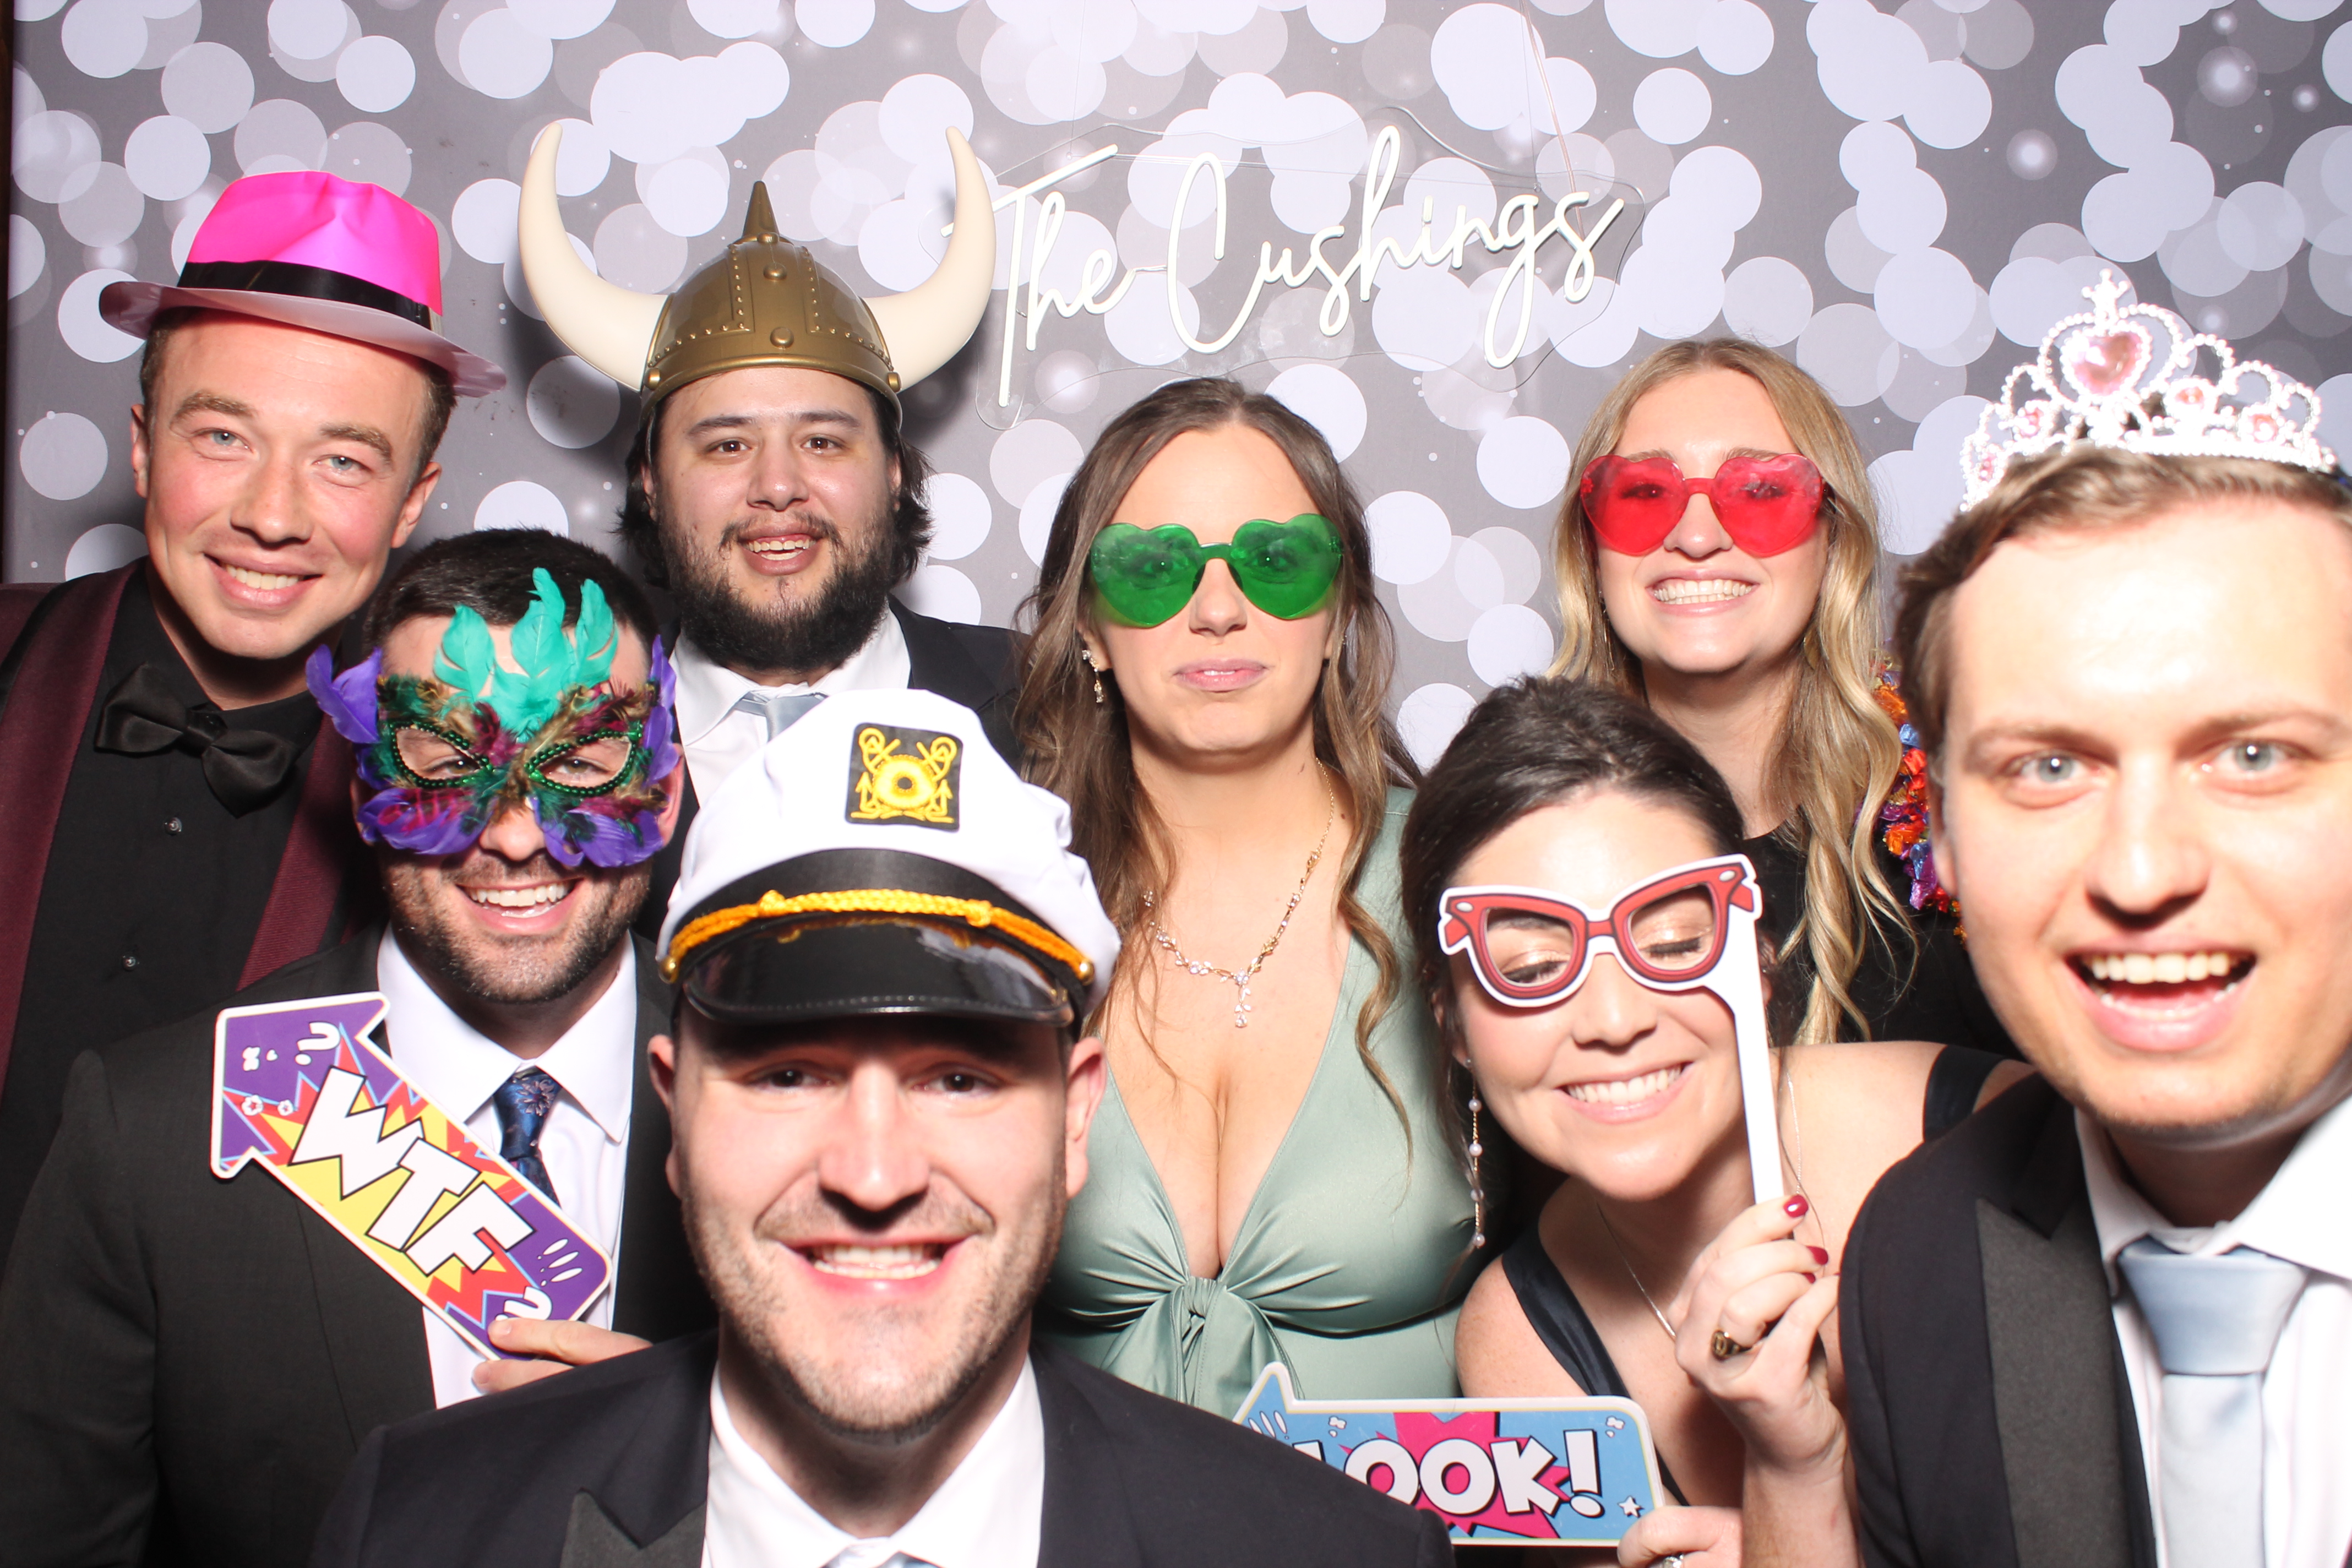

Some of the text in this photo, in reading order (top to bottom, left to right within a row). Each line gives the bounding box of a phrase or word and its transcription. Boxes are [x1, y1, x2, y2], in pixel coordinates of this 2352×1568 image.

[941, 125, 1625, 407] The Cushings
[286, 1065, 538, 1278] WTF
[1291, 1427, 1605, 1519] OOK!
